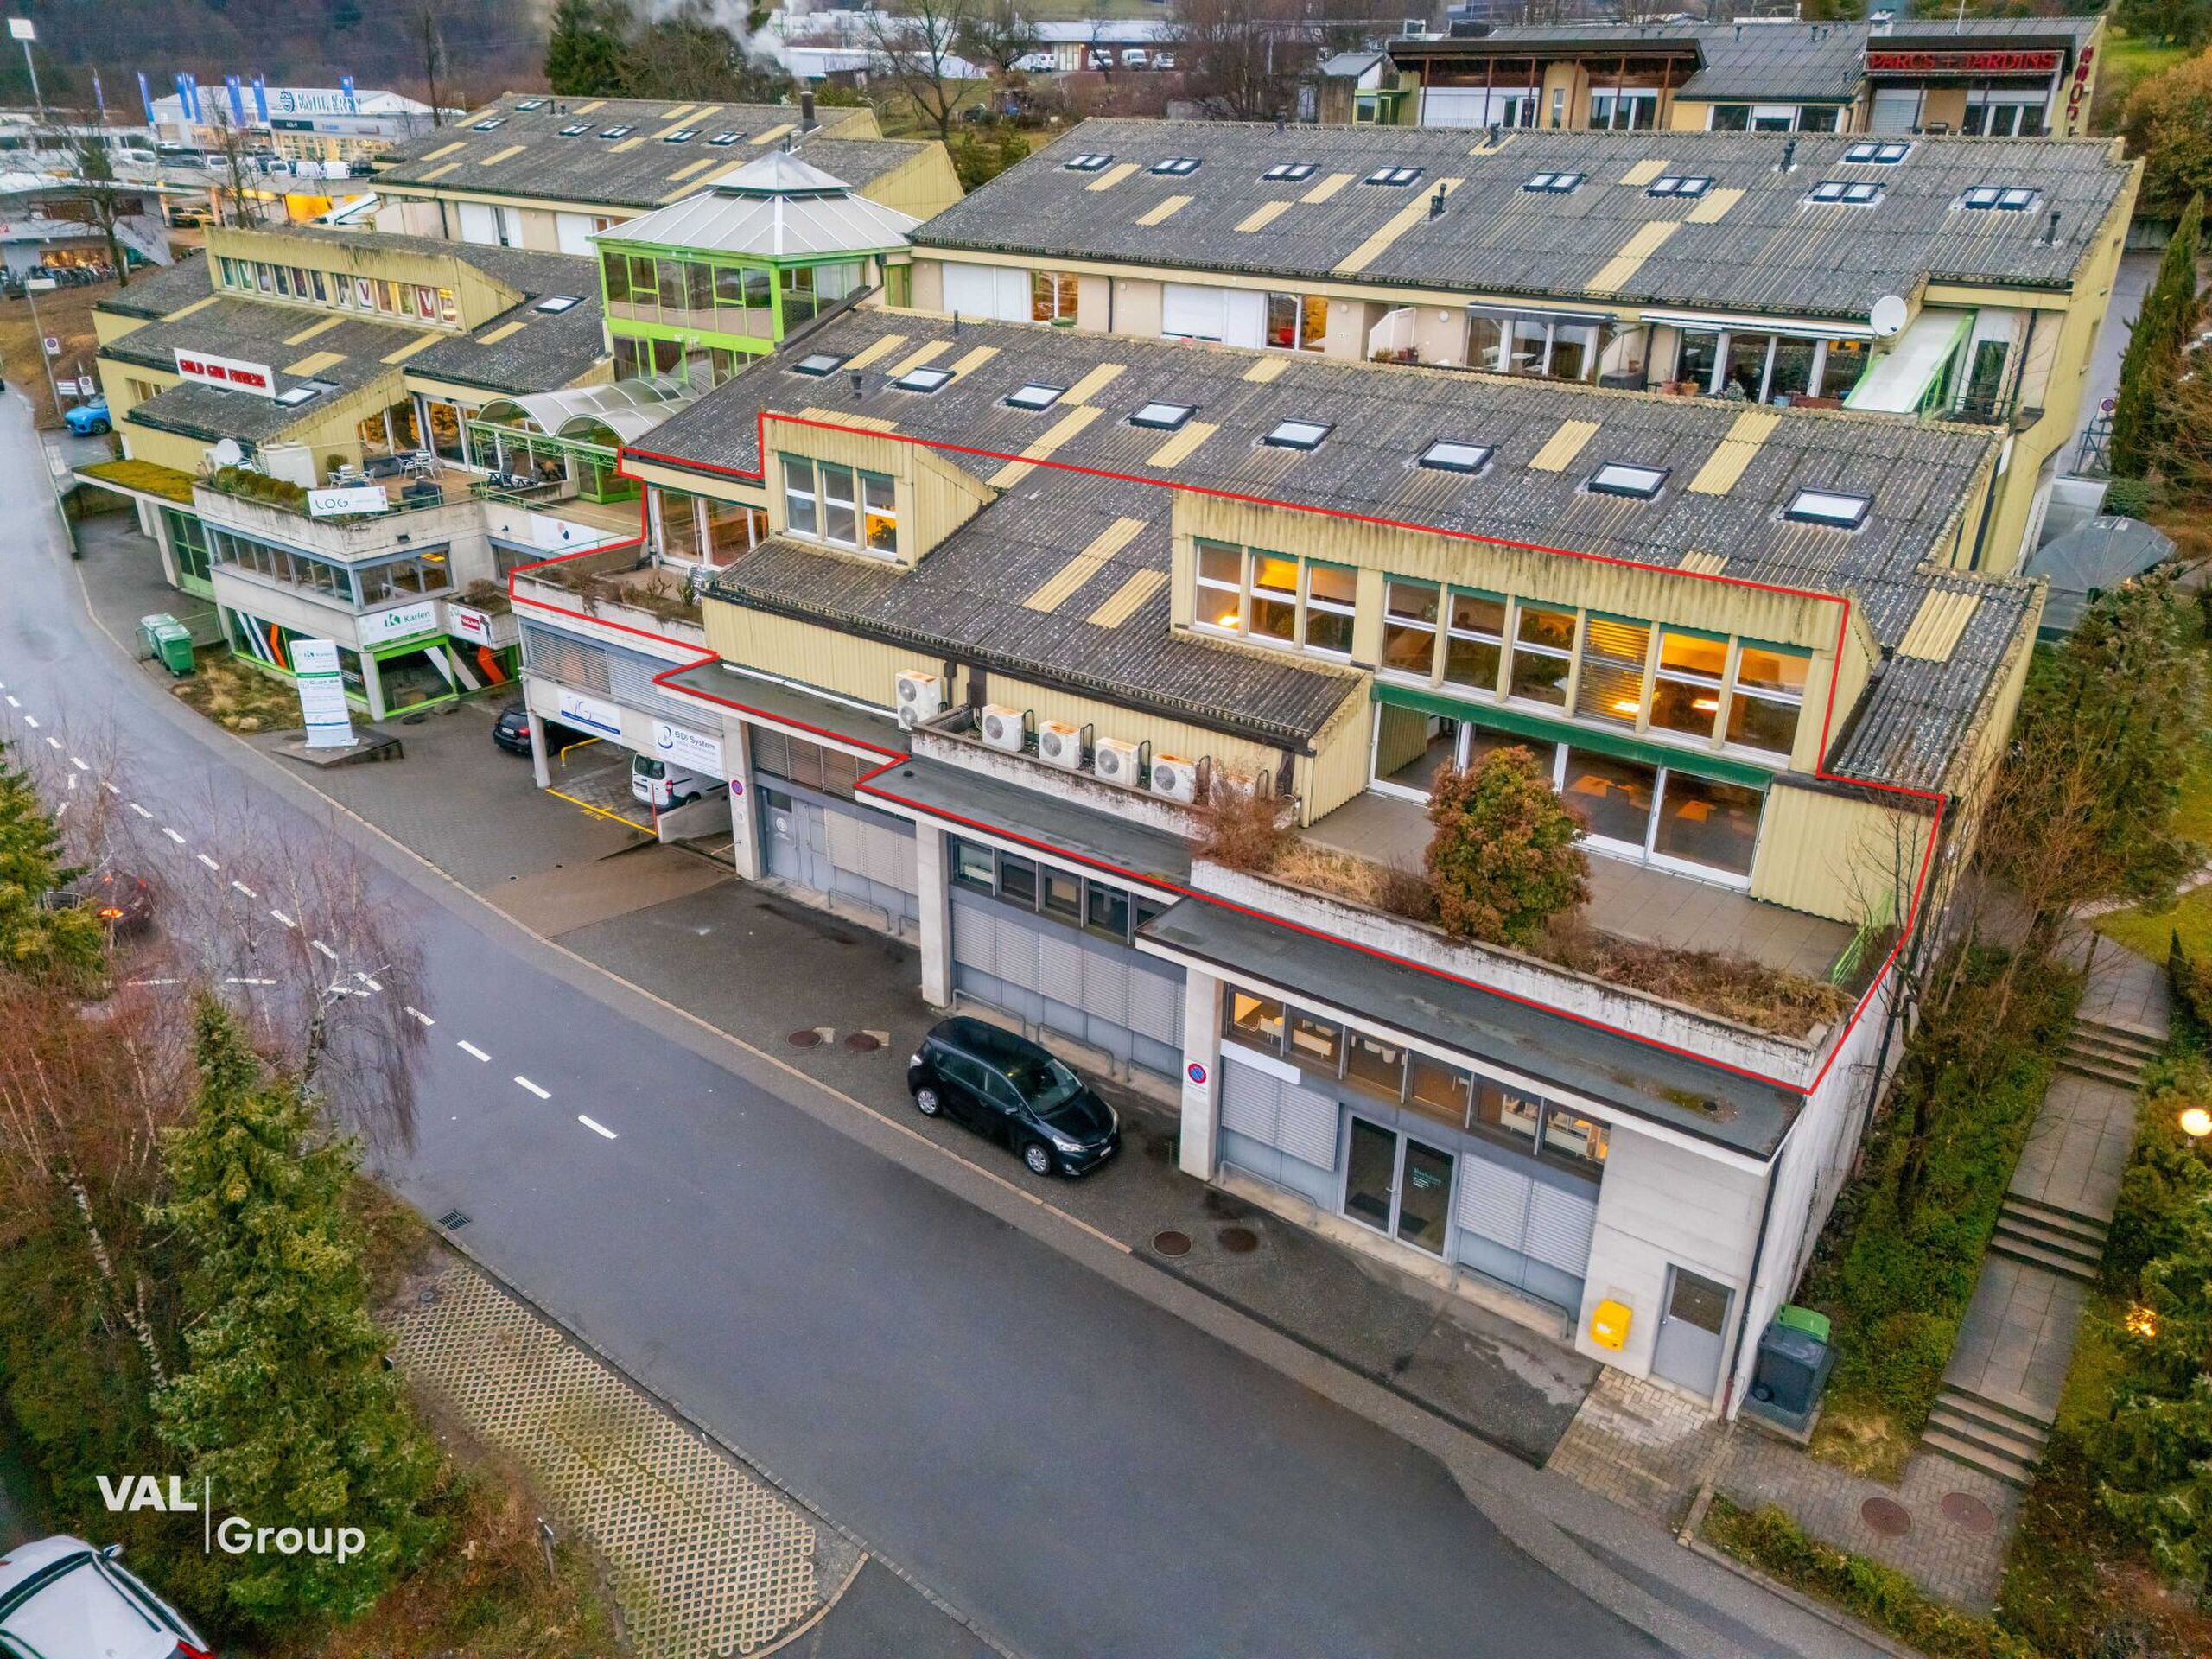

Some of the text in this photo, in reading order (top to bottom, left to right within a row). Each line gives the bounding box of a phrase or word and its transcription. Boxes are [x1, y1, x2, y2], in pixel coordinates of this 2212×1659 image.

[1869, 54, 1936, 70] PARCS
[1964, 53, 2055, 70] JARDINS
[404, 610, 431, 623] Karlen
